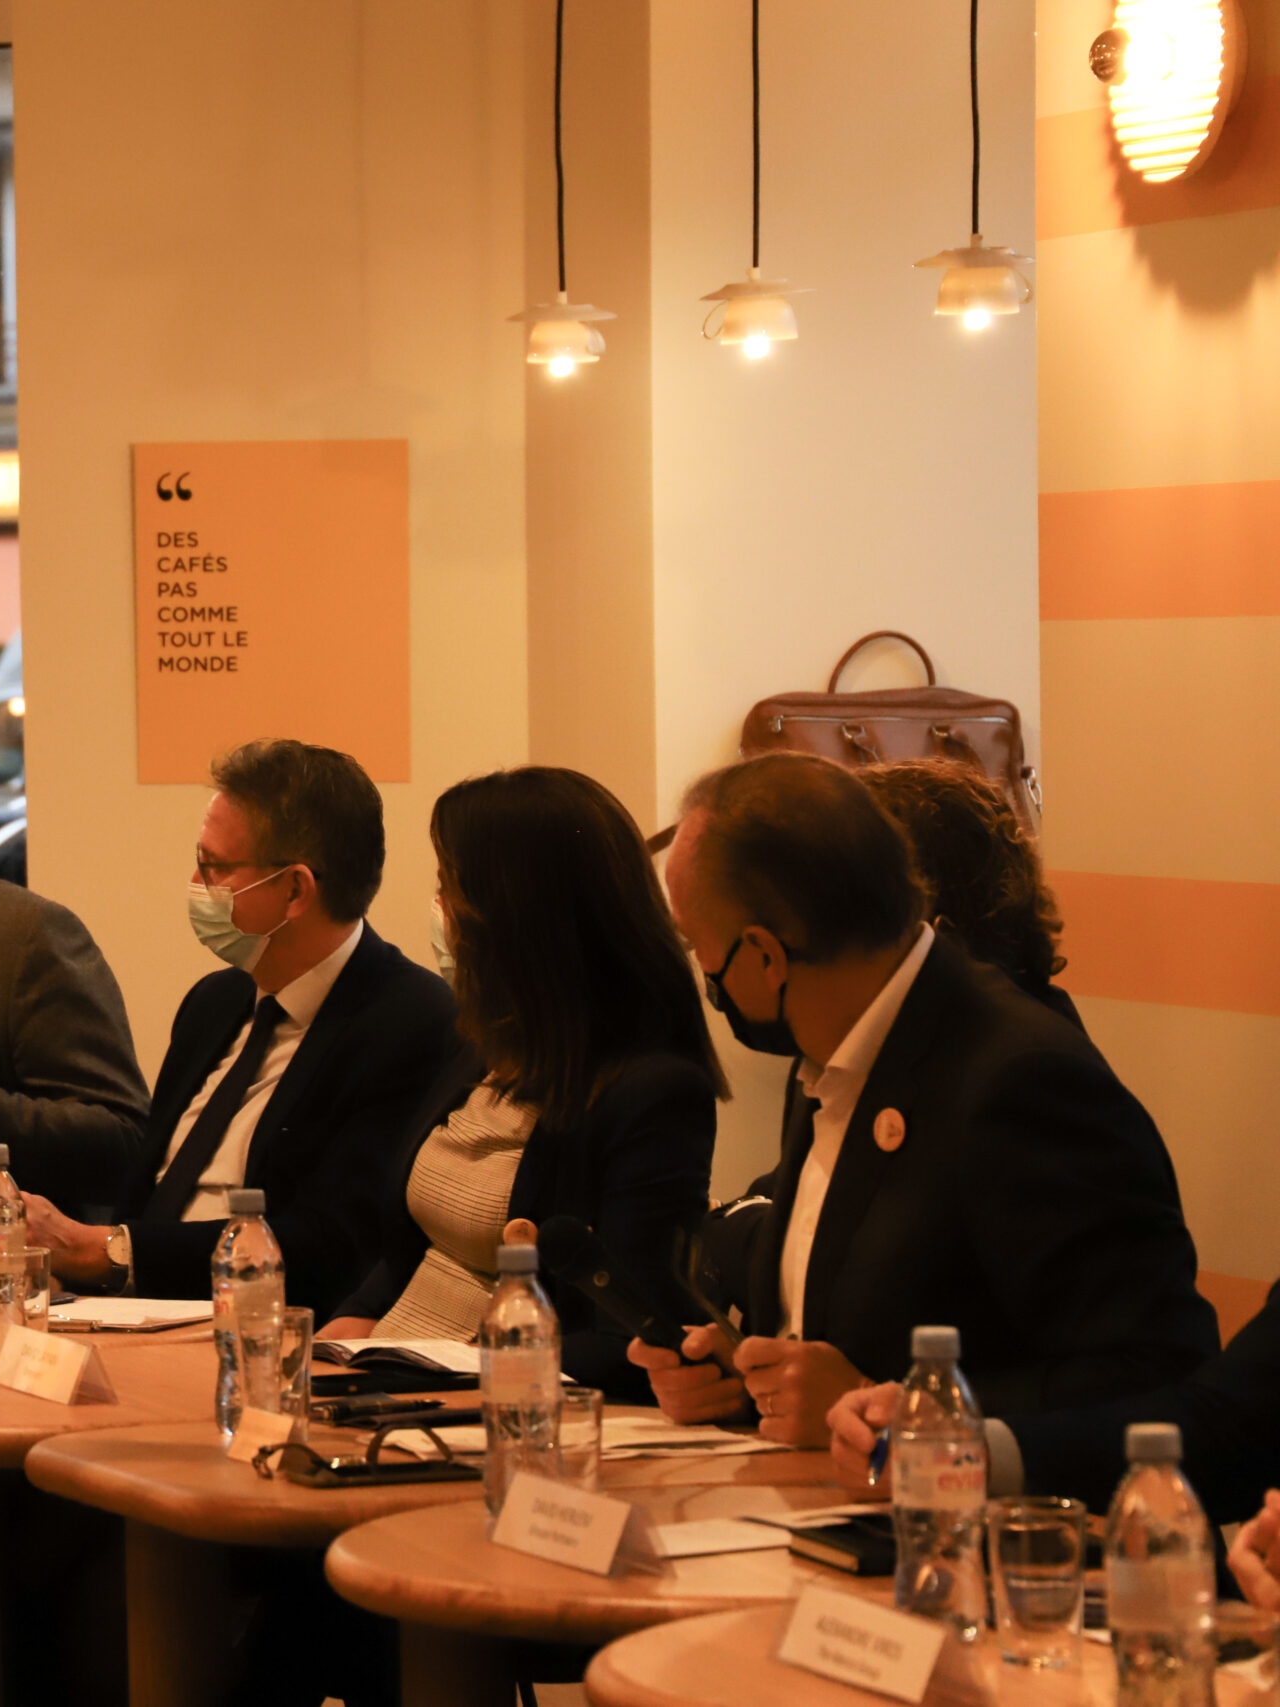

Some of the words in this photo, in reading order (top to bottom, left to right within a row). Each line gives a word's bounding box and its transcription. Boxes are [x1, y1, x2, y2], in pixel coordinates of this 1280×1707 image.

[157, 531, 199, 548] DES
[157, 553, 228, 573] CAFÉS
[158, 582, 198, 598] PAS
[158, 606, 238, 623] COMME
[158, 631, 216, 648] TOUT
[223, 631, 248, 647] LE
[158, 656, 238, 673] MONDE
